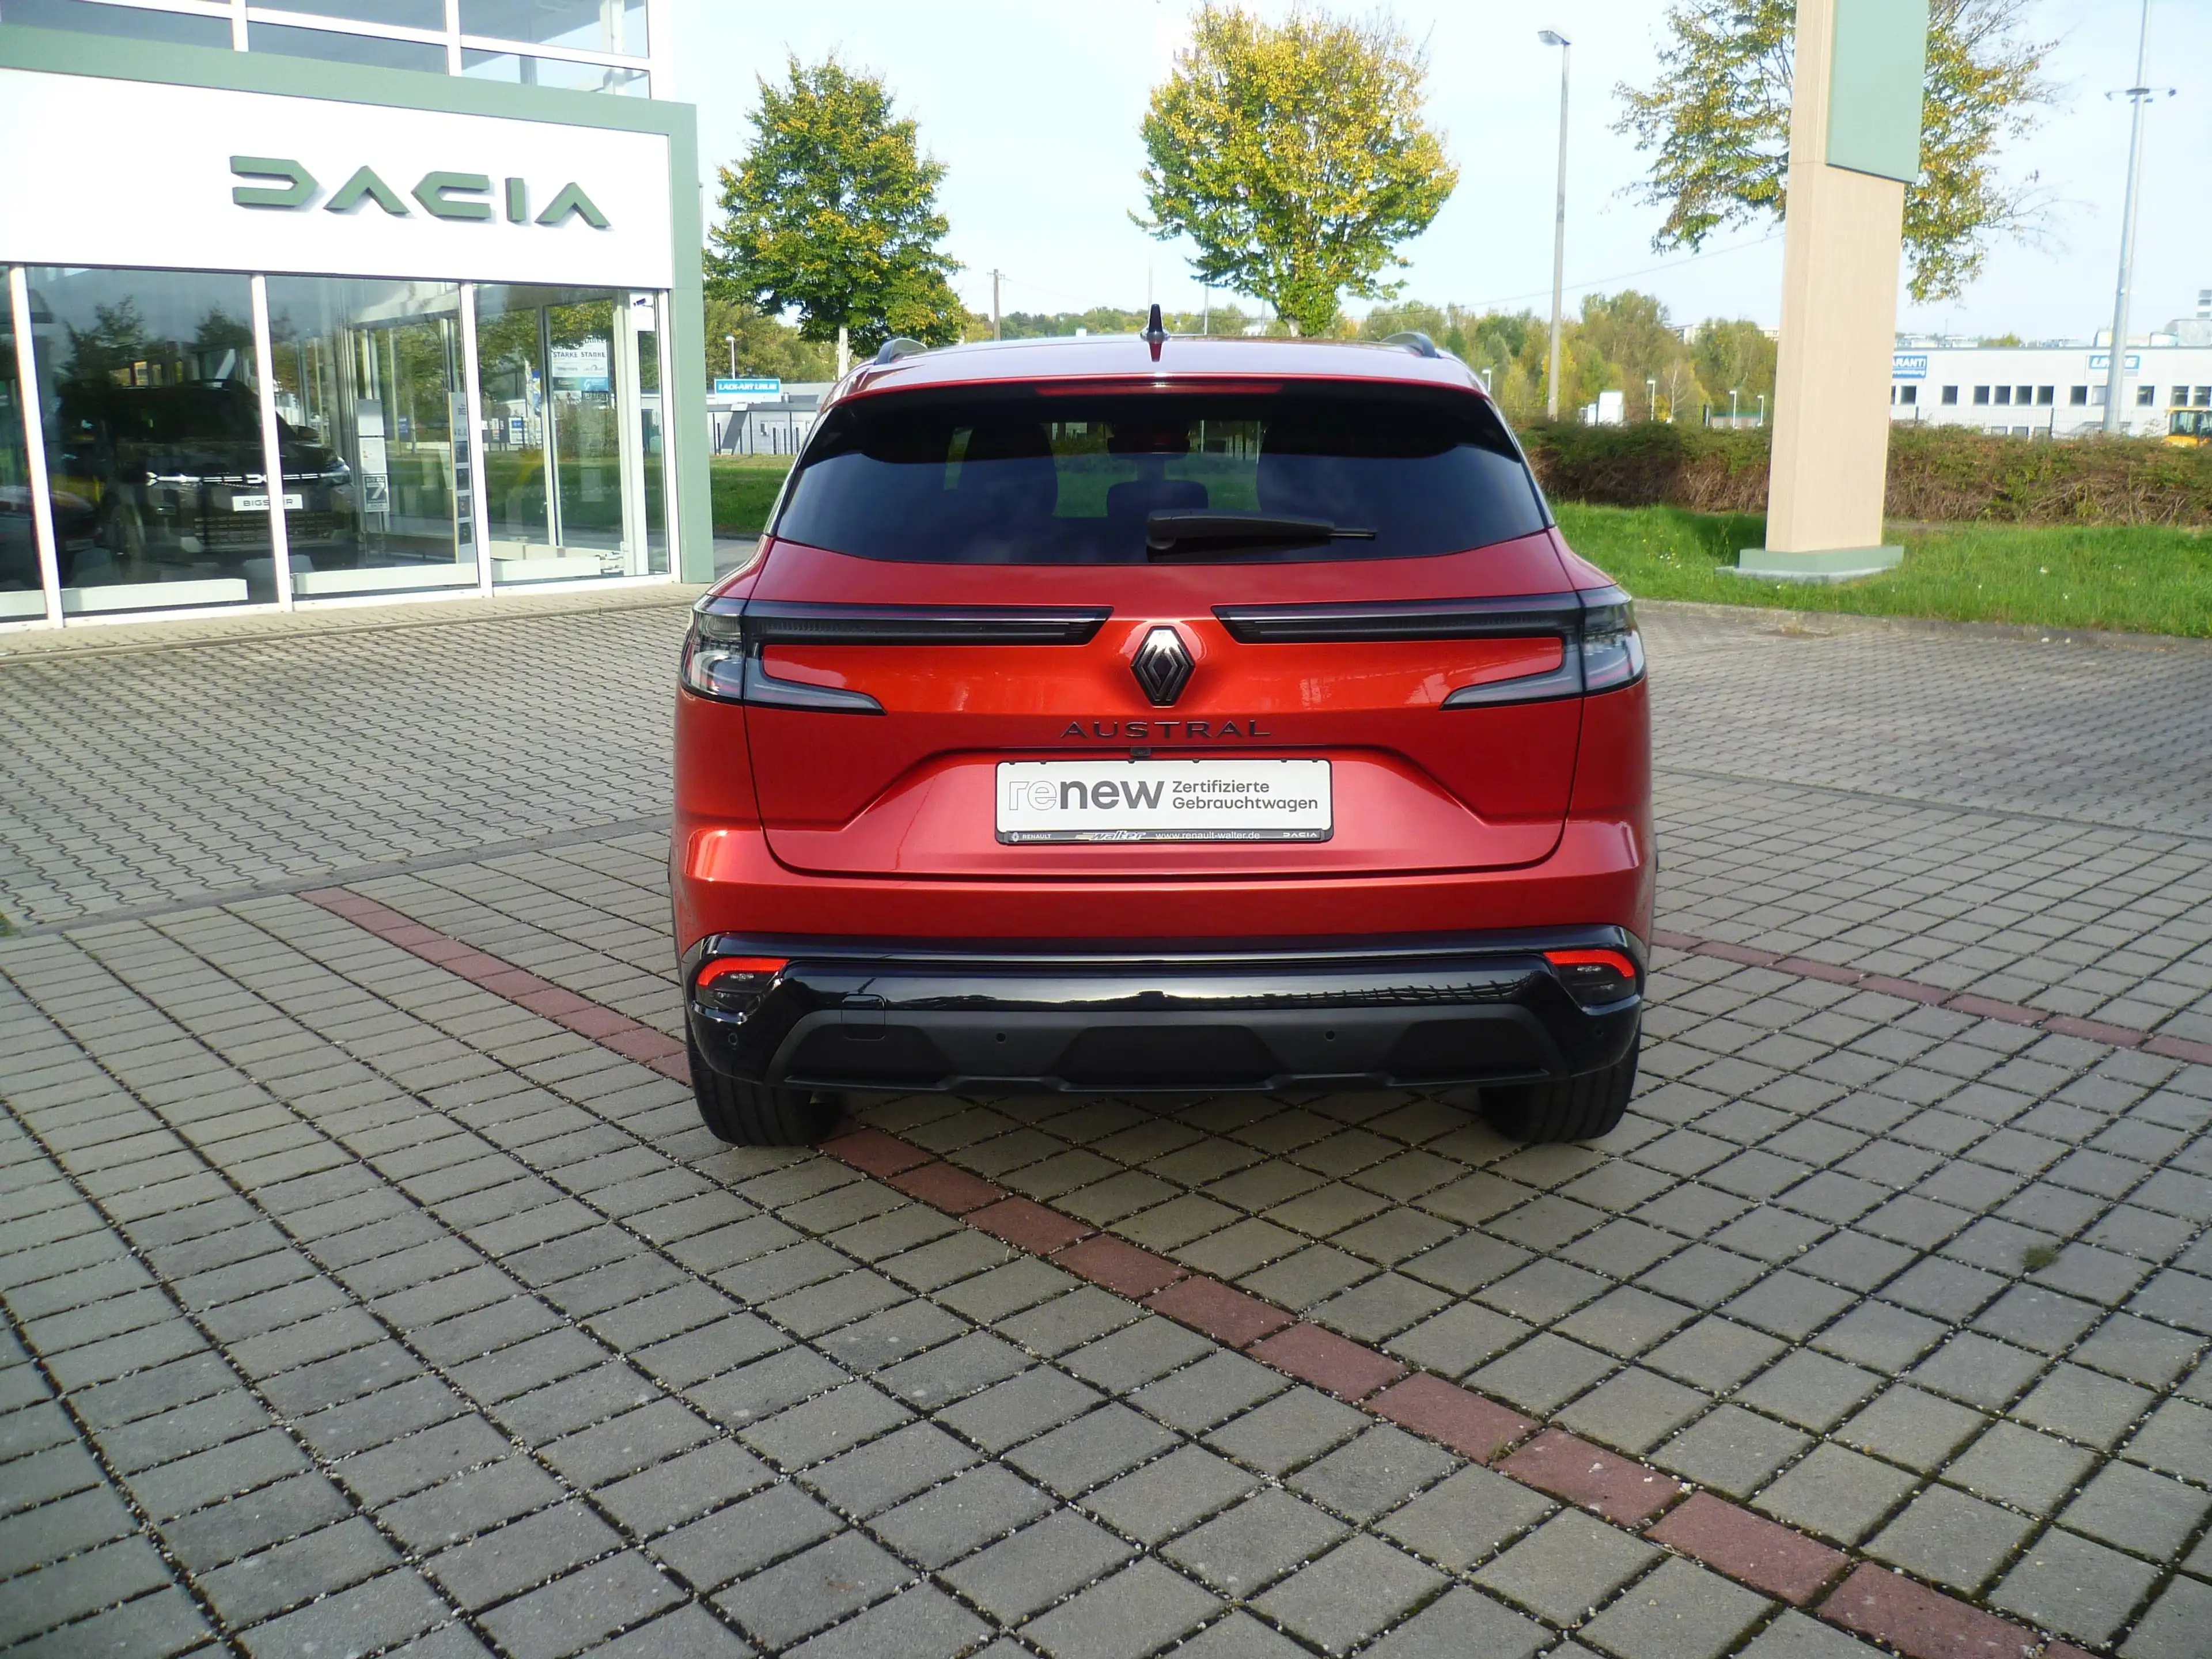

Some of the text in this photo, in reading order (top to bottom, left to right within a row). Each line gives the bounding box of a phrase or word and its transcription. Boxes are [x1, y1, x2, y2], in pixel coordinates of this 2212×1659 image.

[229, 155, 612, 228] DACIA
[243, 498, 293, 506] BIGSR
[1059, 720, 1270, 738] AUSTRAL
[1172, 779, 1270, 793] Zertifizierte
[1009, 780, 1165, 810] renew
[1172, 796, 1319, 813] Gebrauchtwagen
[1155, 831, 1260, 840] www.renault-walter.de
